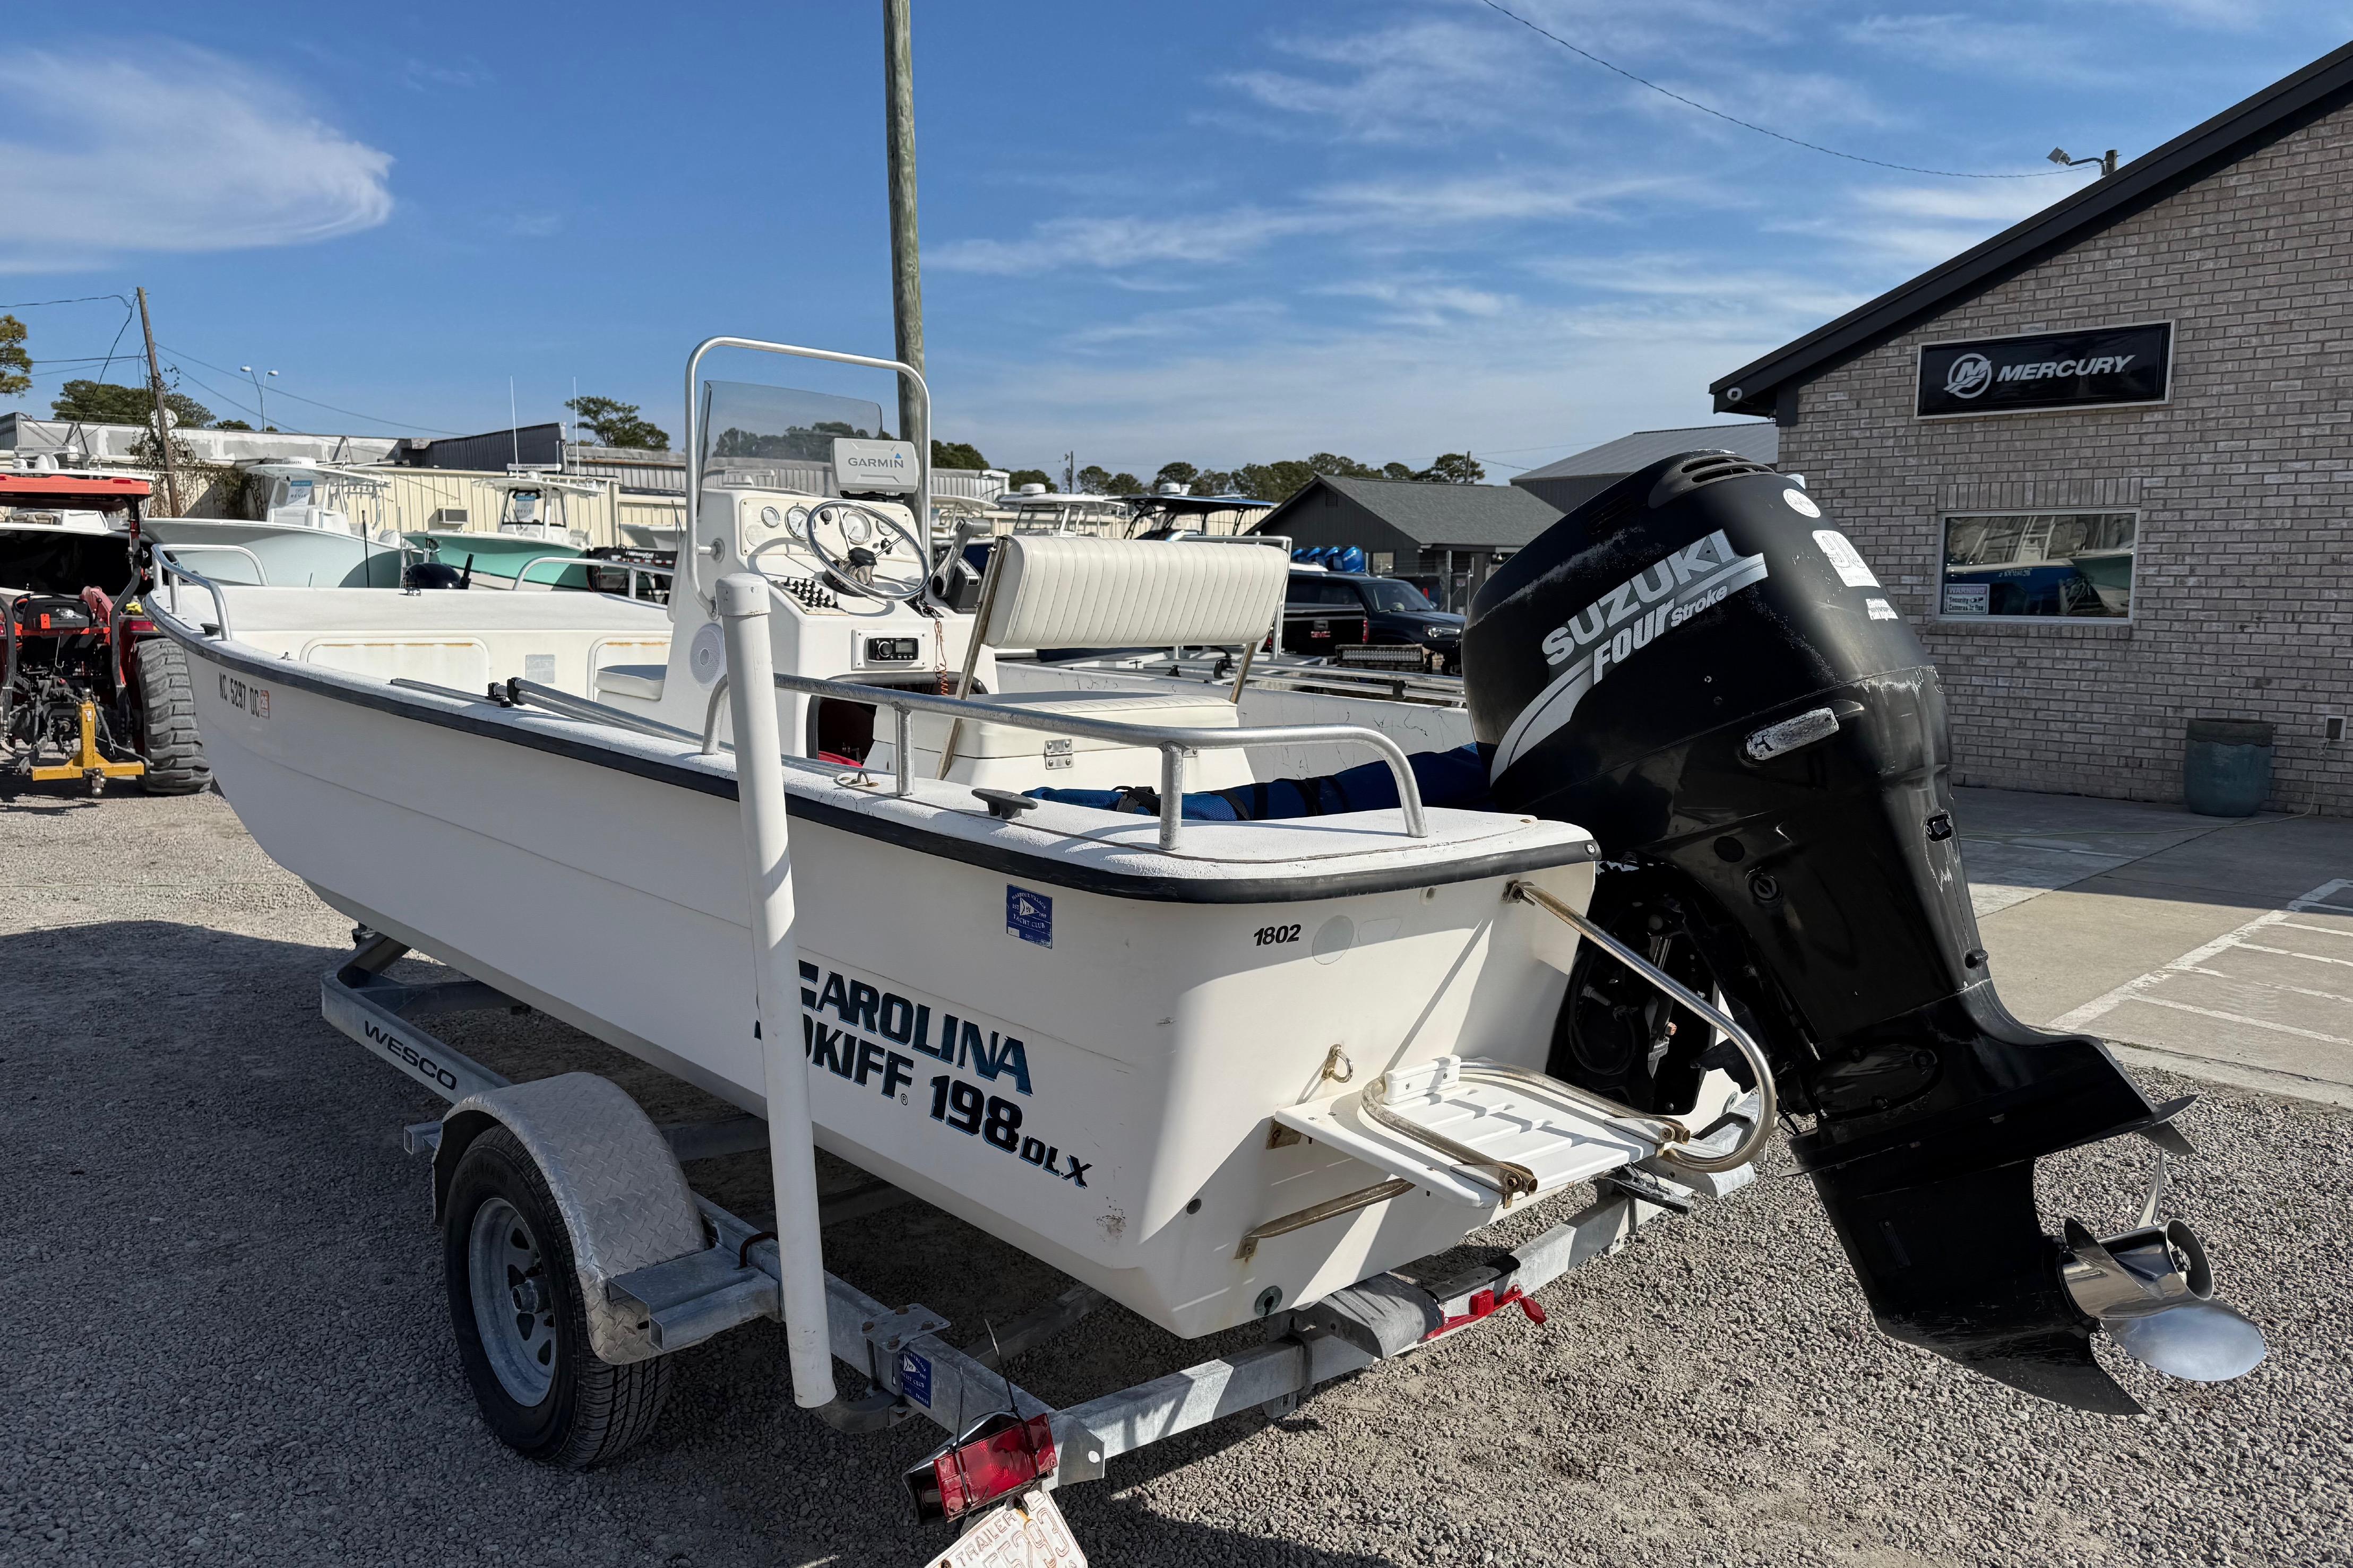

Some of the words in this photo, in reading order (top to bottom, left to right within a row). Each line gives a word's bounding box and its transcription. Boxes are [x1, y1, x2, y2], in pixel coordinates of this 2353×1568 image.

[1996, 355, 2136, 382] MERCURY
[848, 457, 904, 468] GARMIN
[1542, 529, 1735, 665] SUZUKI
[219, 671, 227, 701] NC
[230, 678, 246, 711] 5297
[249, 687, 260, 717] DC
[1013, 913, 1029, 926] YACHT
[1254, 924, 1302, 946] 1802
[365, 1020, 458, 1090] WESCO
[803, 1013, 914, 1099] KIFF
[930, 1075, 1023, 1154] 198
[1019, 1136, 1093, 1189] DLX
[956, 1511, 1017, 1567] TRAILER
